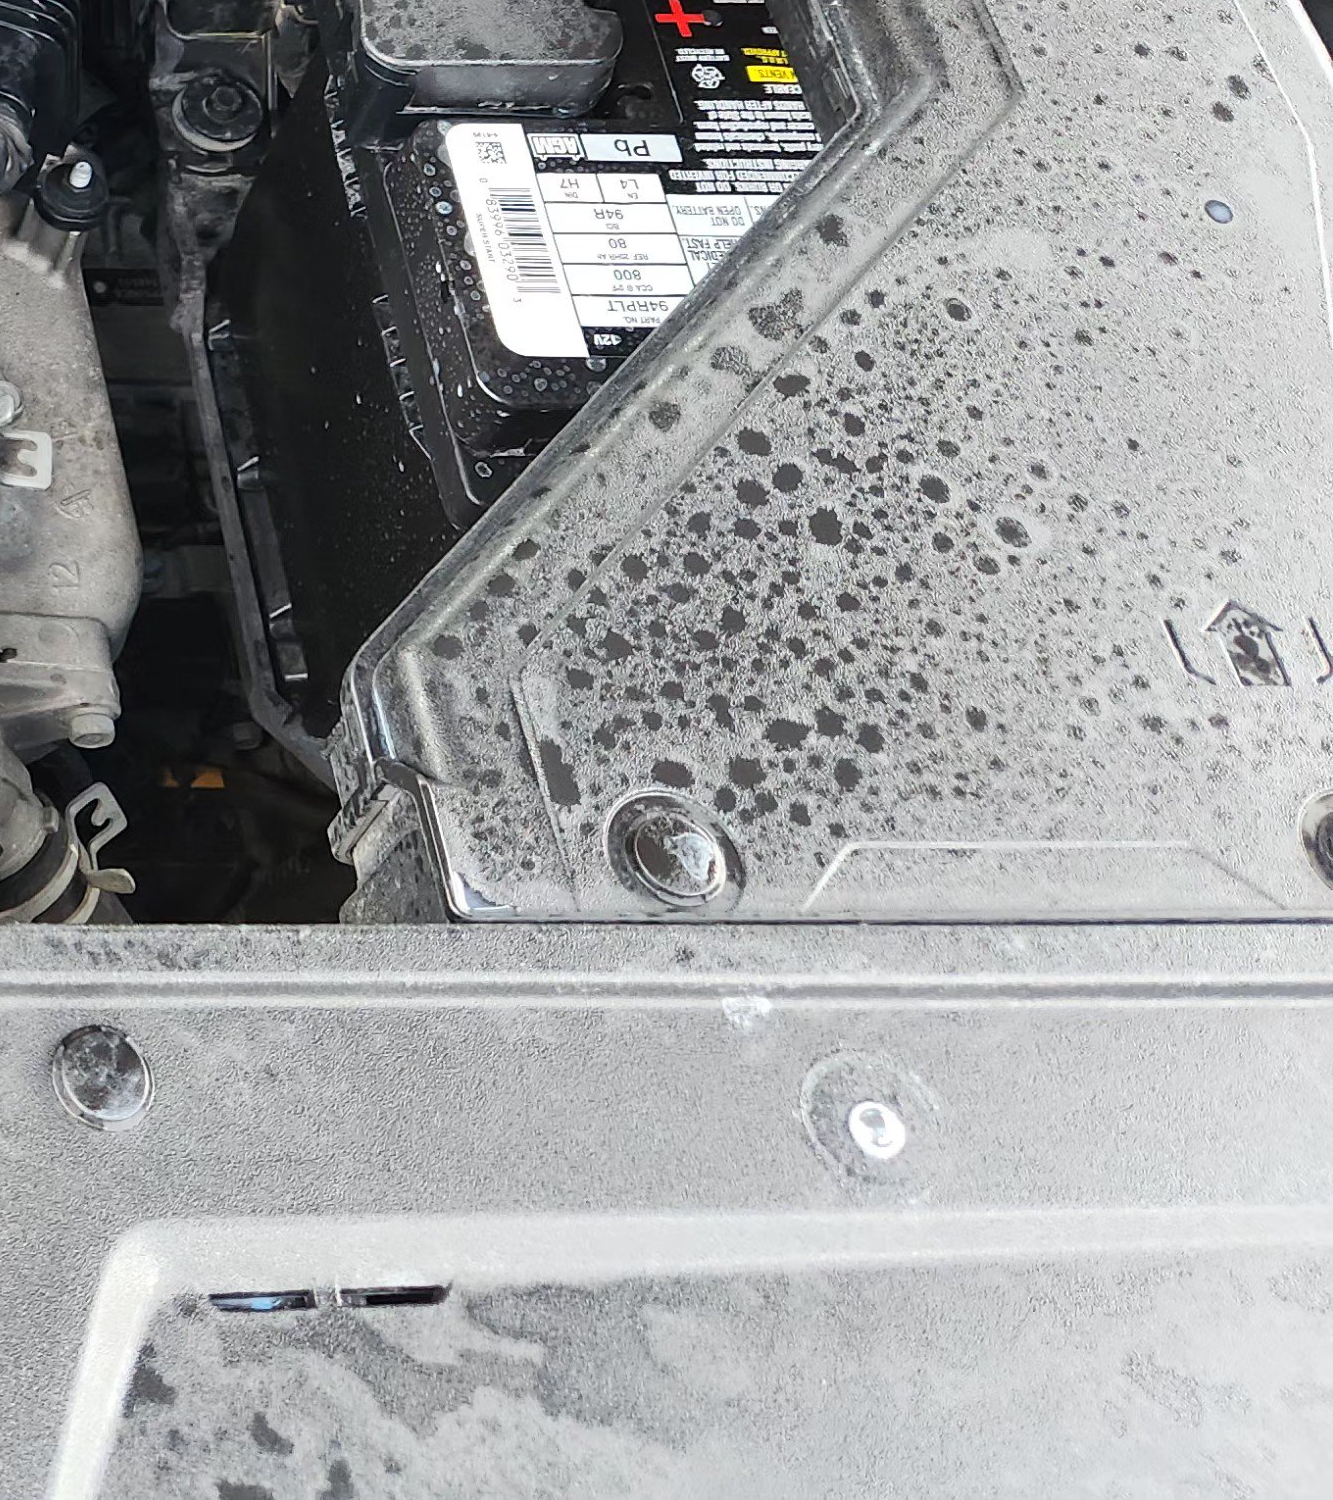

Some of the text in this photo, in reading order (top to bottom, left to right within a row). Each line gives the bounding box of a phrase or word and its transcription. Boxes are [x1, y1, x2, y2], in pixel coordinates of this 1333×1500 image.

[614, 139, 650, 156] Pb
[560, 178, 579, 189] H7
[619, 179, 639, 189] L4
[593, 208, 624, 219] 94R
[731, 217, 745, 226] DO
[485, 199, 504, 236] 83996
[497, 242, 520, 282] 03290
[608, 238, 627, 248] 80
[613, 270, 641, 280] 800
[607, 301, 669, 312] 94RPLT
